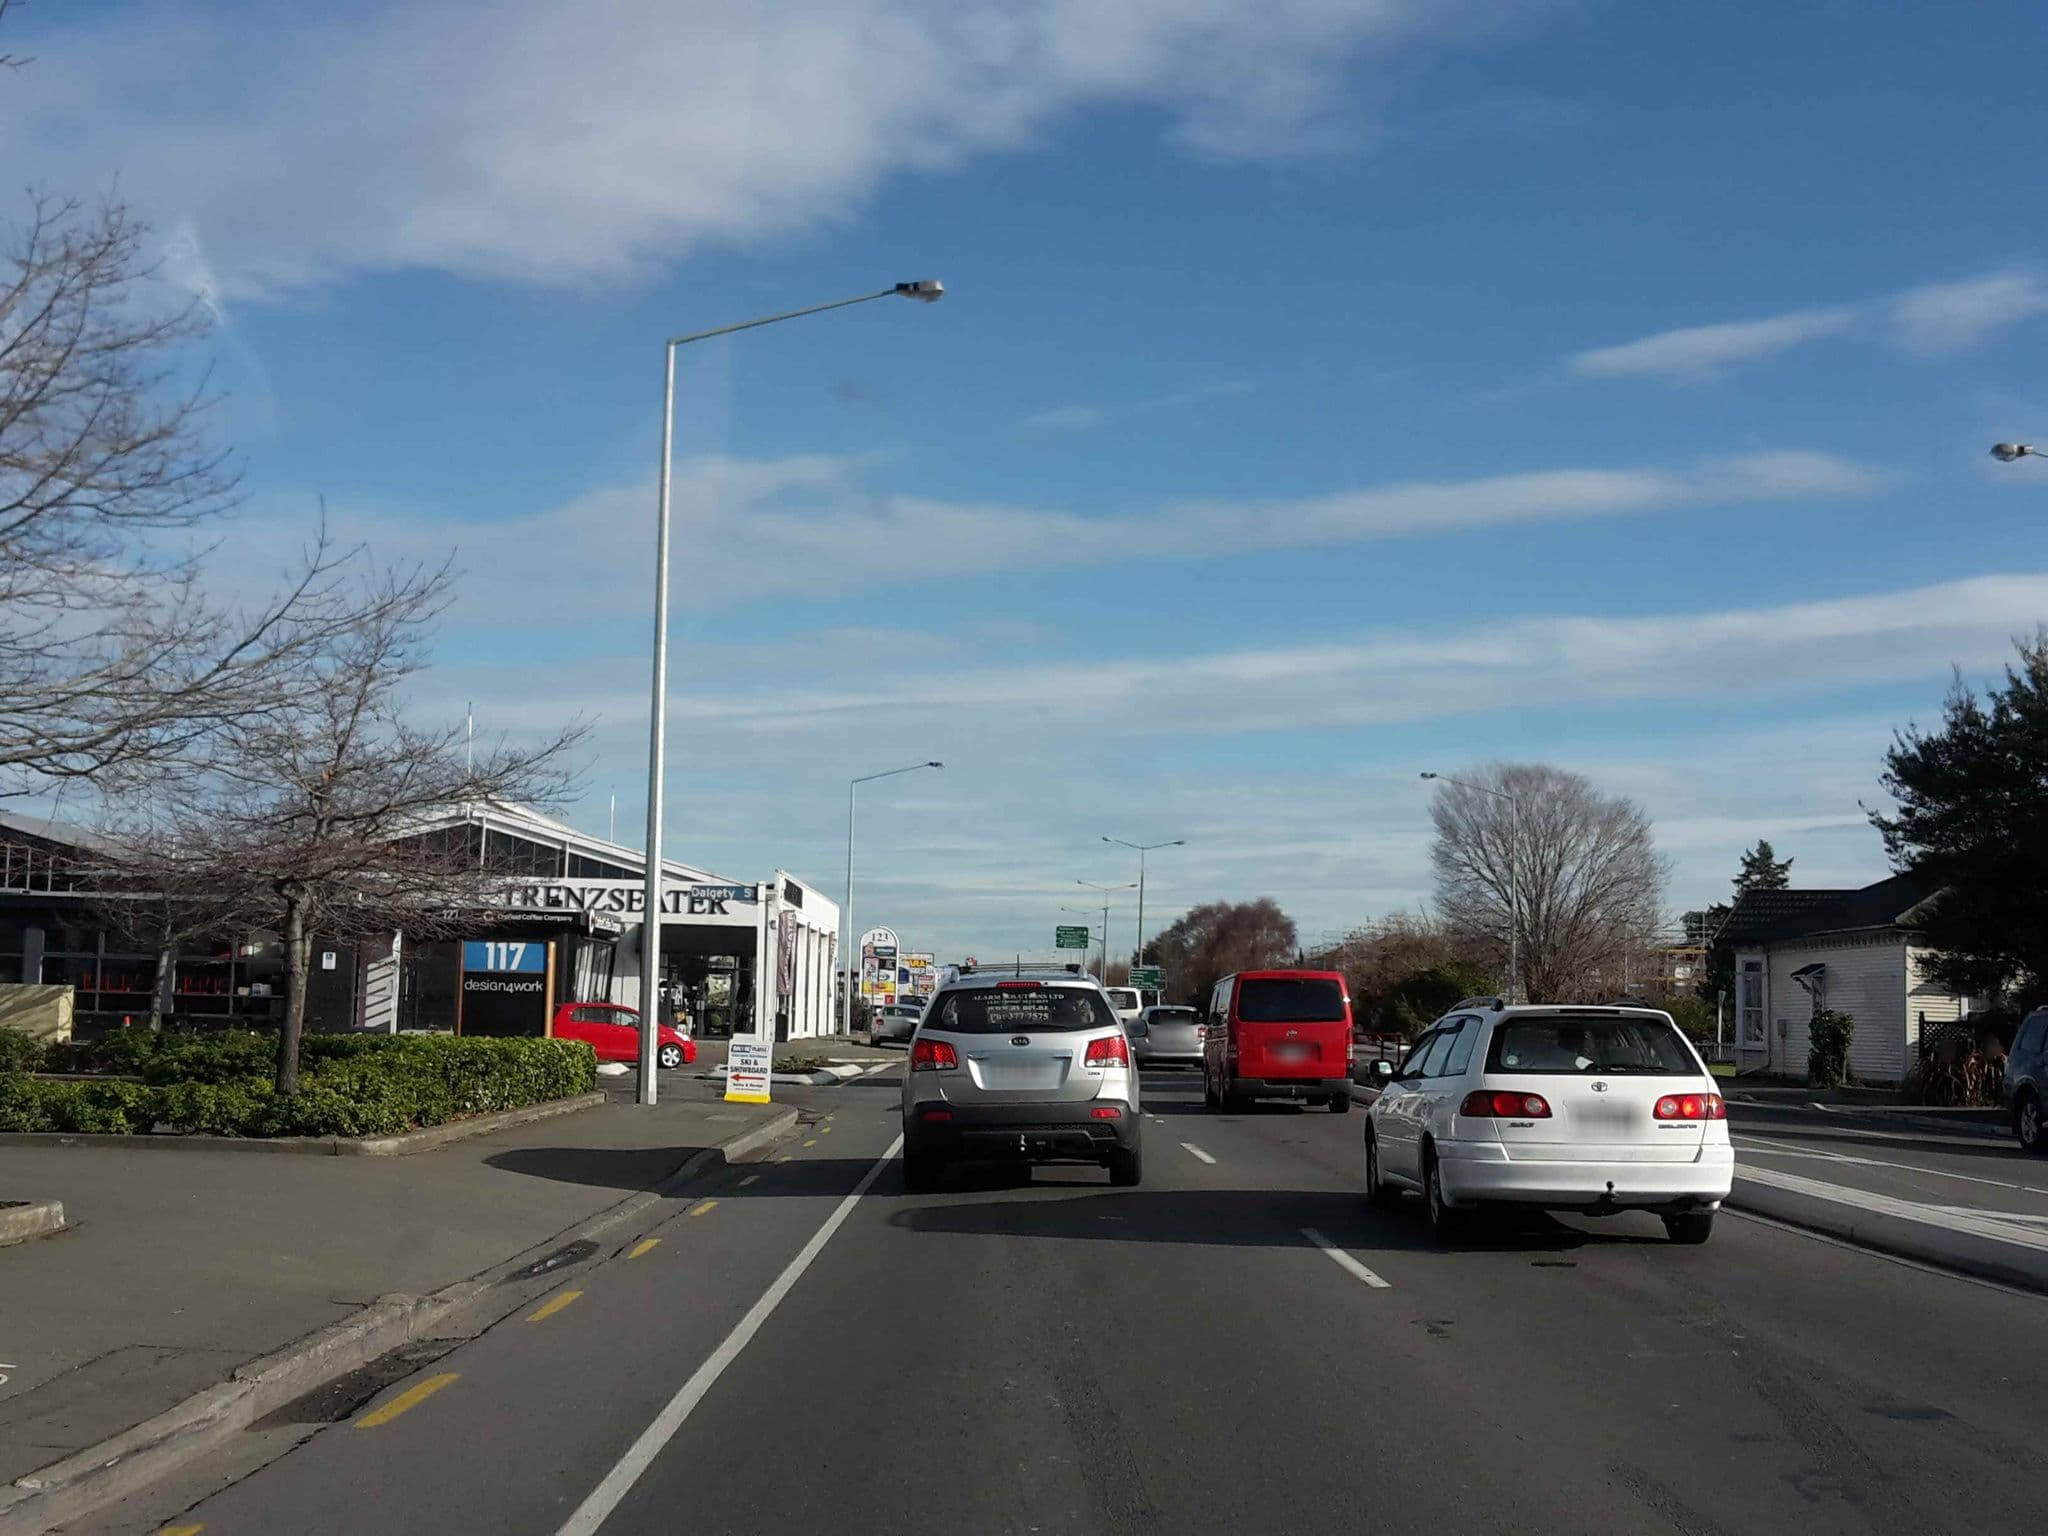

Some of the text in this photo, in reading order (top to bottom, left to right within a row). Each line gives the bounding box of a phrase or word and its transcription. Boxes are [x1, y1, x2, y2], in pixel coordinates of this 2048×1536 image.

[692, 887, 735, 900] Dalgety
[544, 914, 574, 923] Company
[871, 933, 889, 942] 123
[485, 942, 526, 970] 117
[464, 980, 543, 994] design4work
[1027, 1012, 1049, 1020] 7575
[730, 1066, 768, 1074] SNOWBOARD
